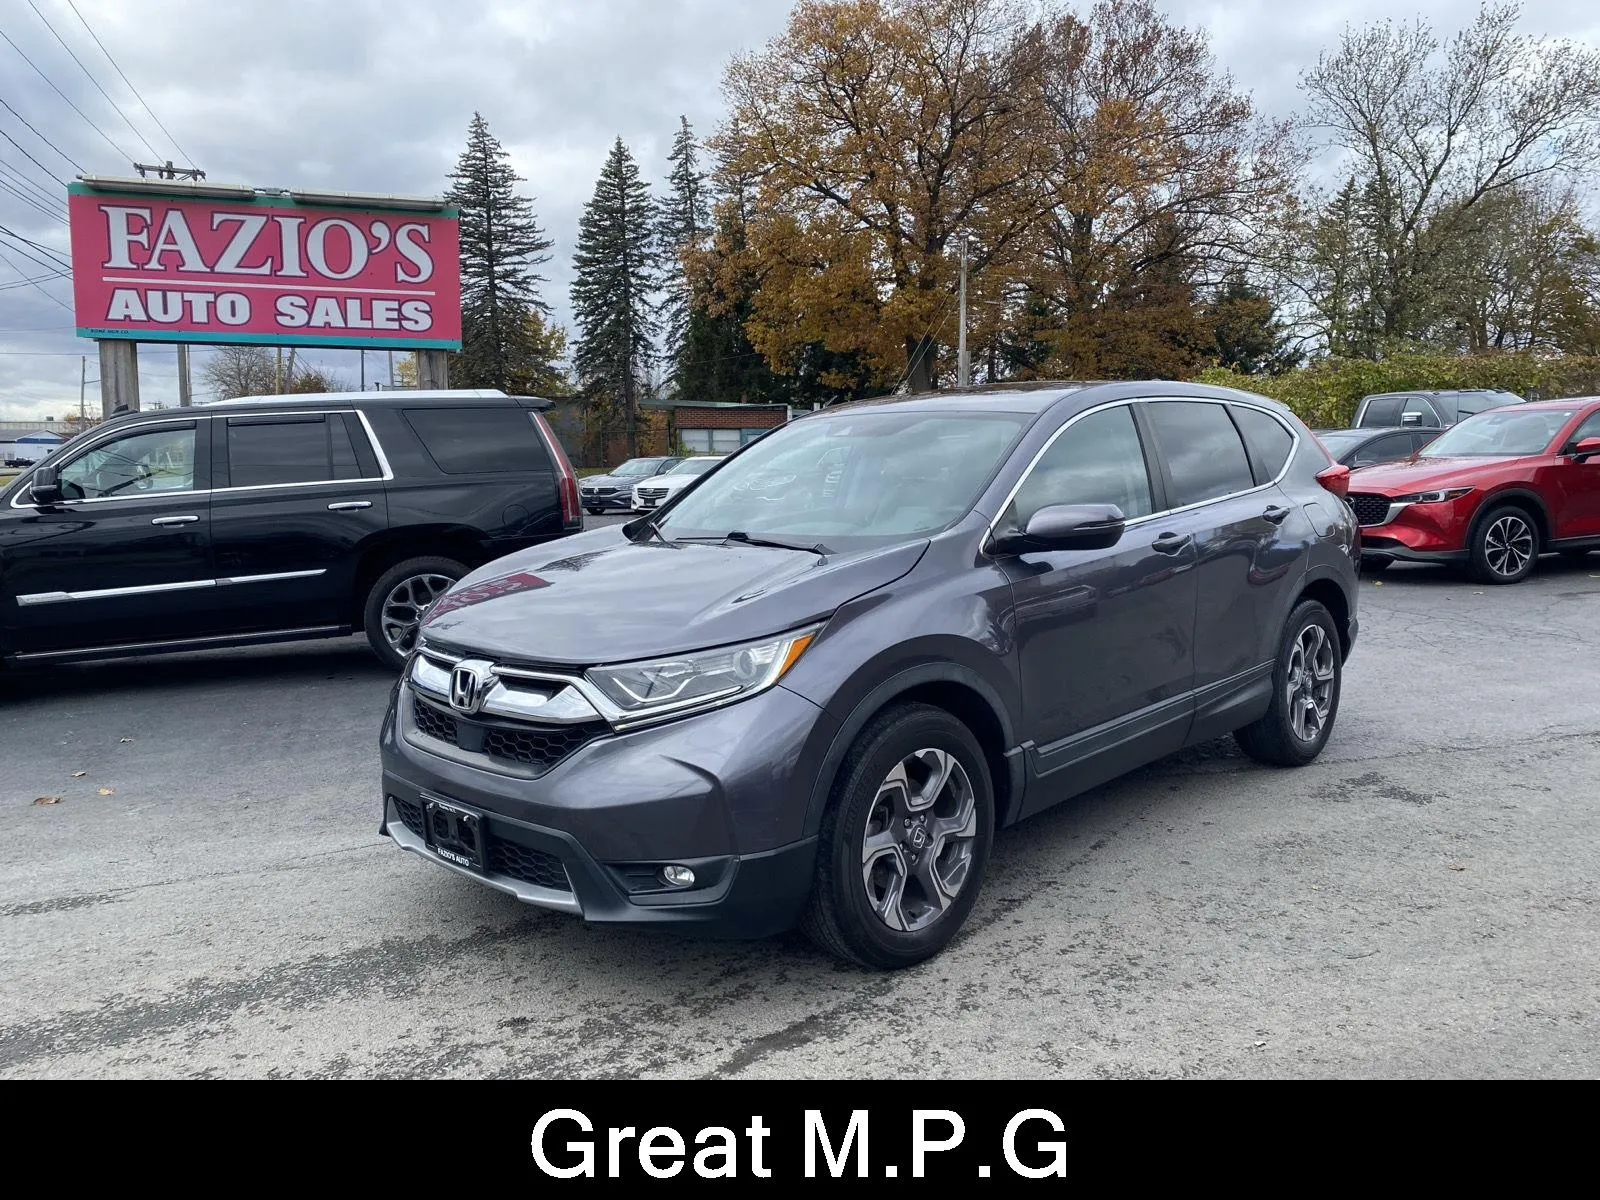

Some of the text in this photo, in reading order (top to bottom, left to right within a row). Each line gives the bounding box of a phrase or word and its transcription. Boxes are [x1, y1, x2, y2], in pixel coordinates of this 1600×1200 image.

[99, 205, 435, 284] FAZIO'S
[106, 288, 433, 331] AUTO SALES
[455, 855, 470, 867] AUTO
